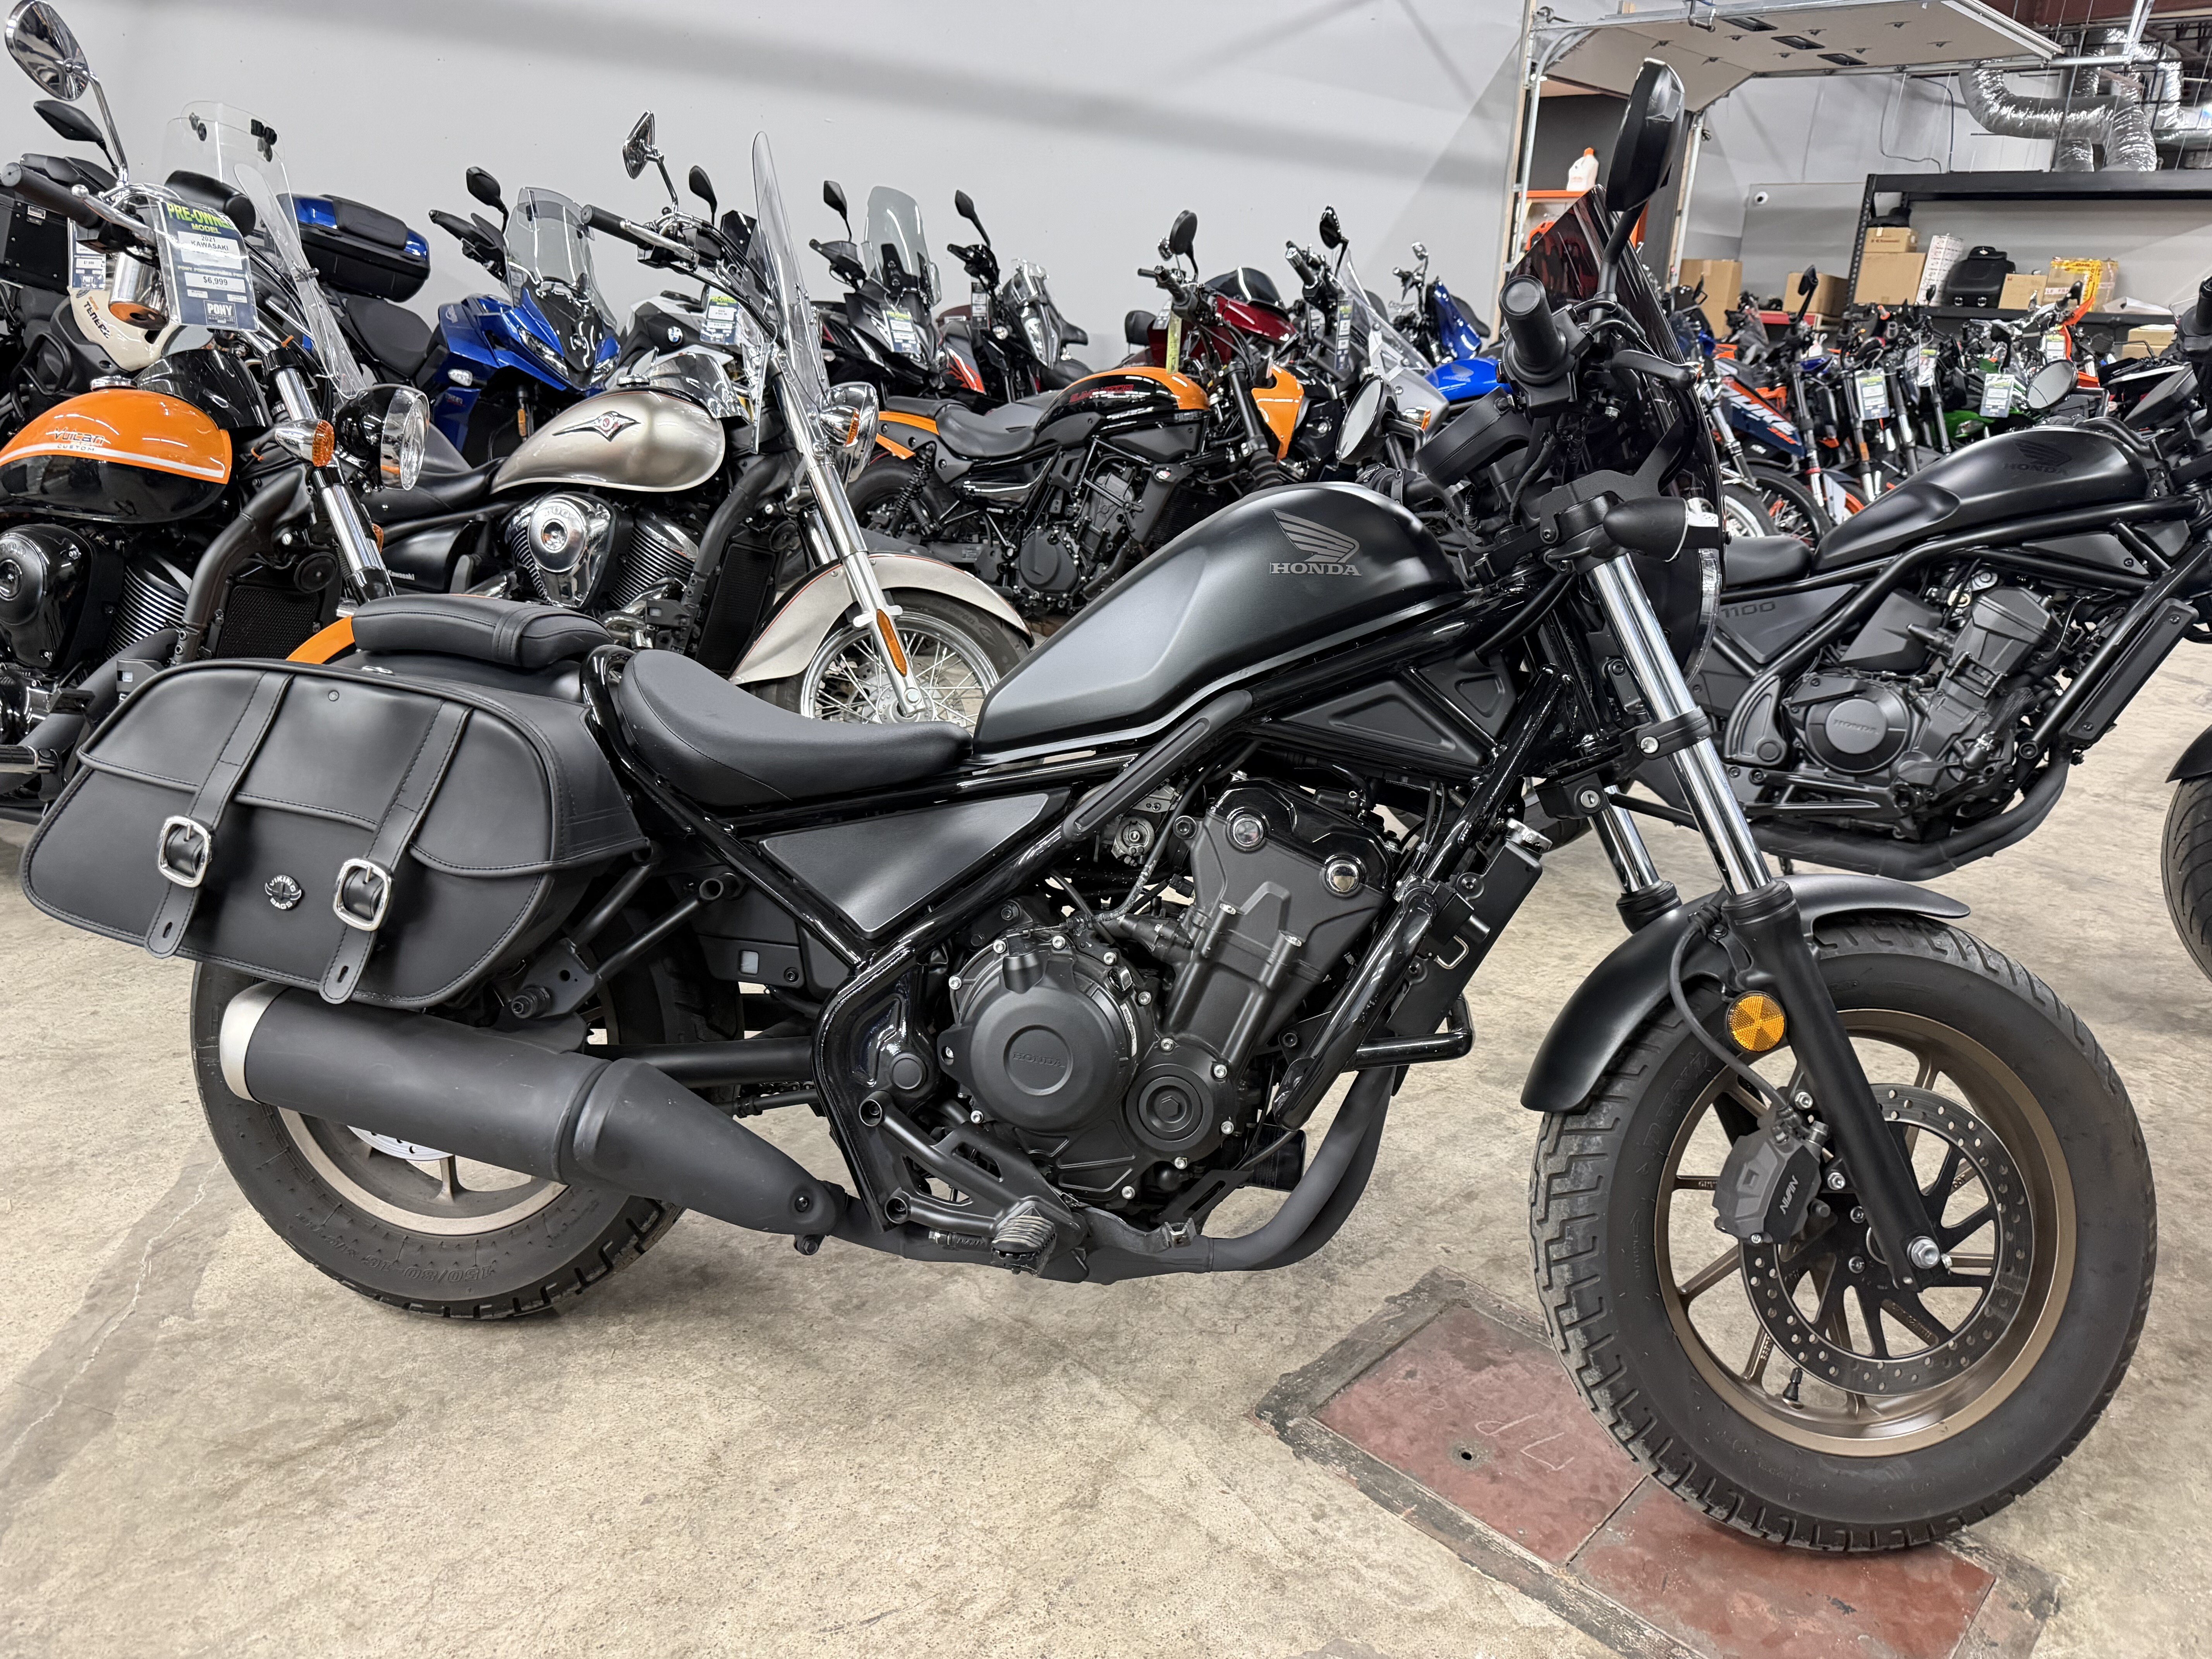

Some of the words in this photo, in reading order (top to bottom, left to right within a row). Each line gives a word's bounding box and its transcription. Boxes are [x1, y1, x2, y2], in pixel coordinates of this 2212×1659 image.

[191, 223, 222, 234] MODEL
[191, 240, 229, 251] KAWASAKI
[203, 276, 228, 286] $6,999
[207, 303, 232, 316] PONY
[2003, 463, 2068, 476] HONDA
[1271, 563, 1362, 576] HONDA
[1721, 601, 1775, 618] 1100
[1833, 719, 1879, 735] HONDA
[270, 876, 296, 892] VIKING
[270, 897, 293, 909] BAGS
[1012, 1052, 1065, 1068] HONDA
